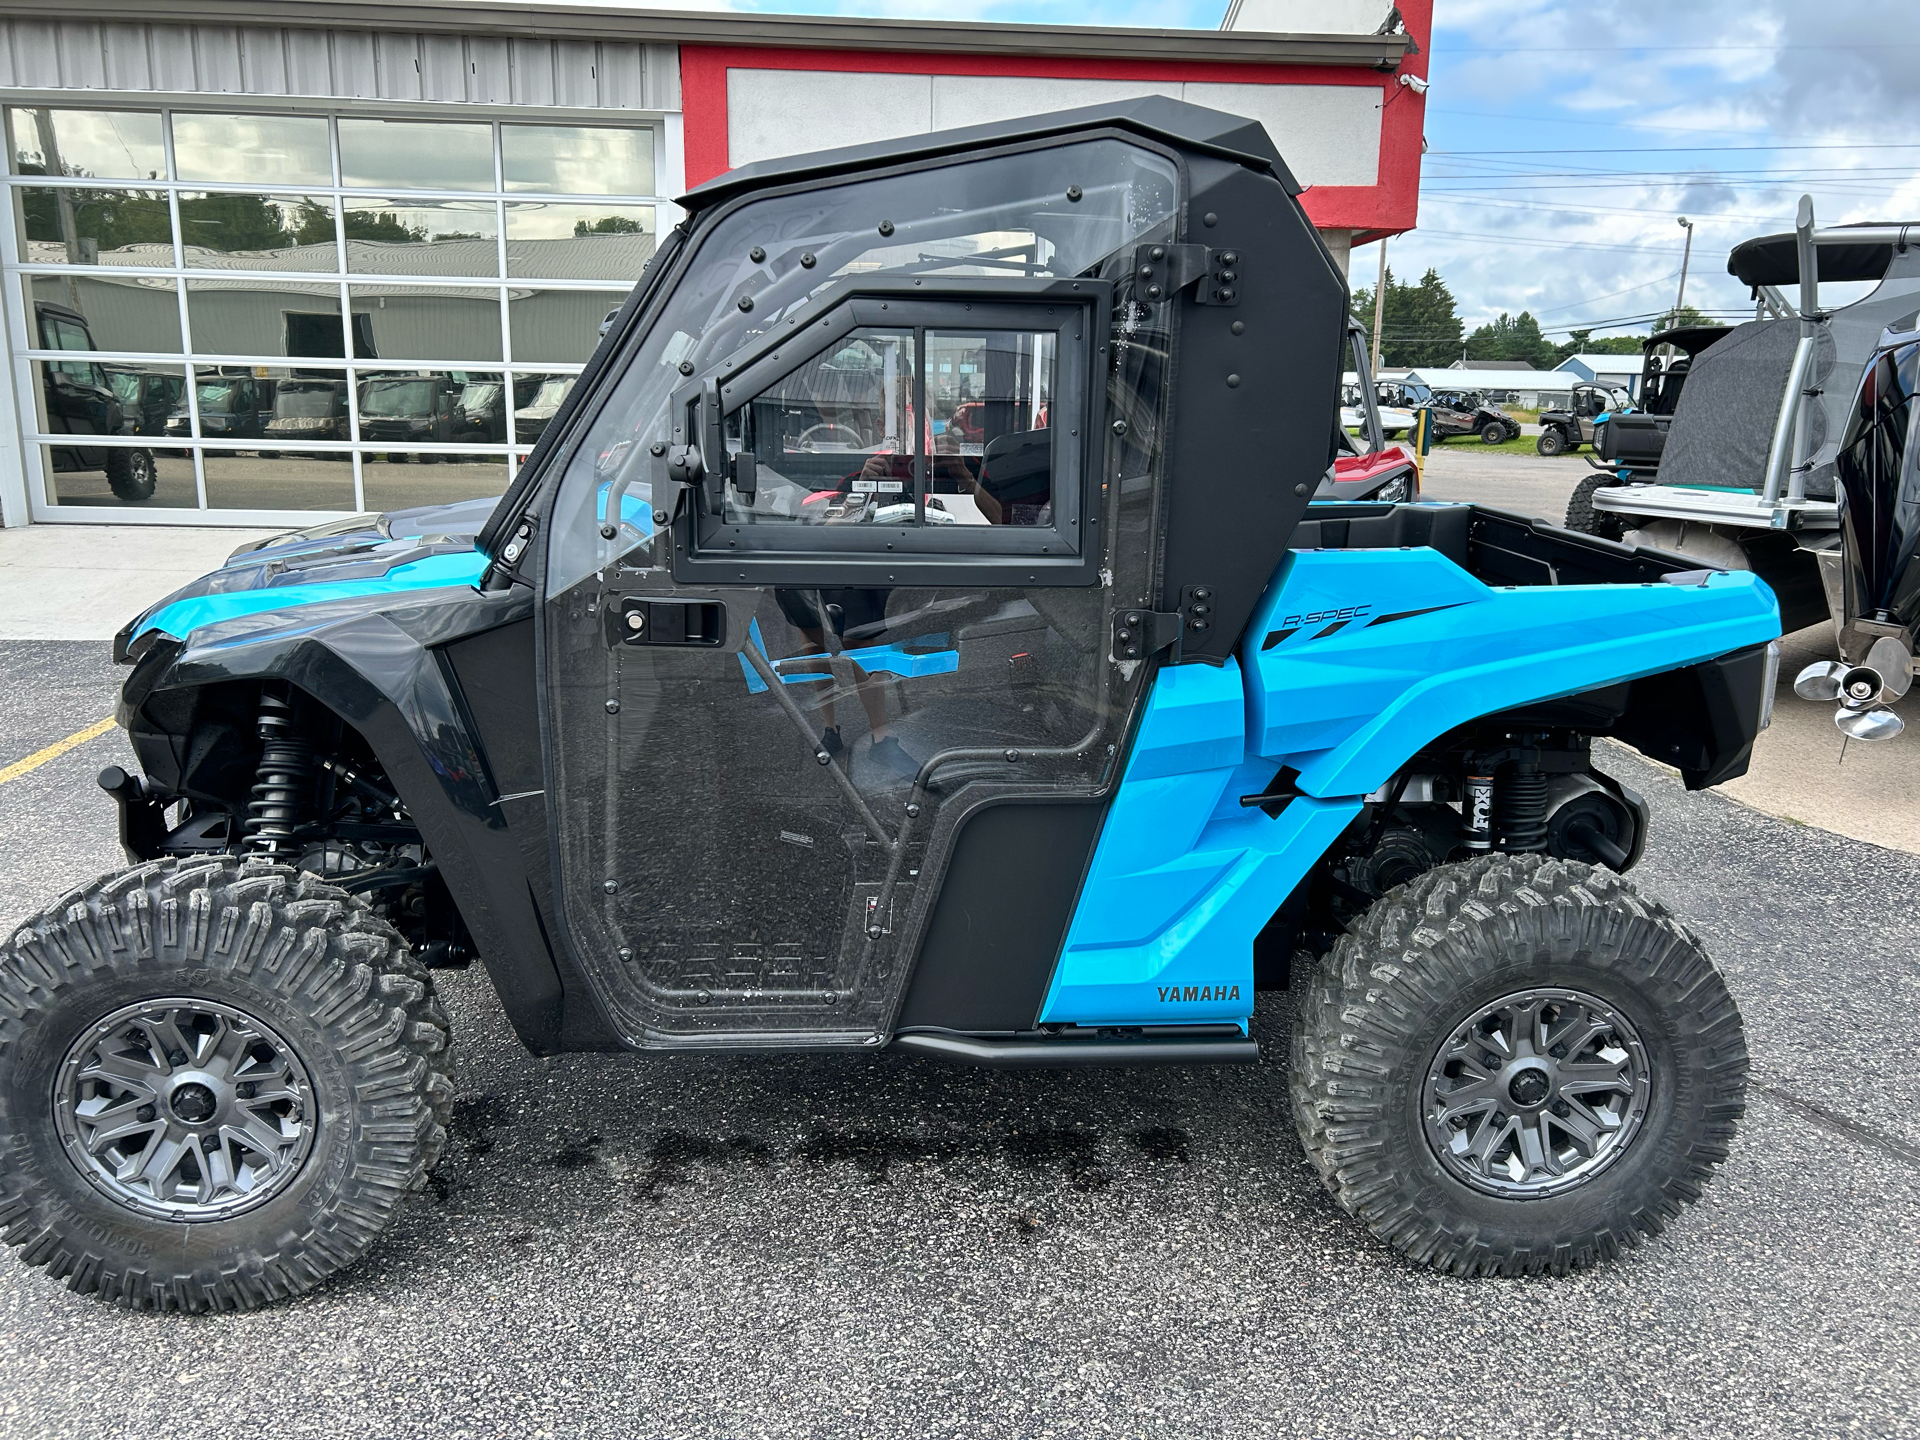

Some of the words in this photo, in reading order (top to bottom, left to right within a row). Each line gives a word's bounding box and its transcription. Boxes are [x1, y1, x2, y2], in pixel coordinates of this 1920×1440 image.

[1472, 788, 1492, 829] FOX
[1157, 985, 1240, 1002] YAMAHA
[300, 1027, 352, 1169] COMMANDER
